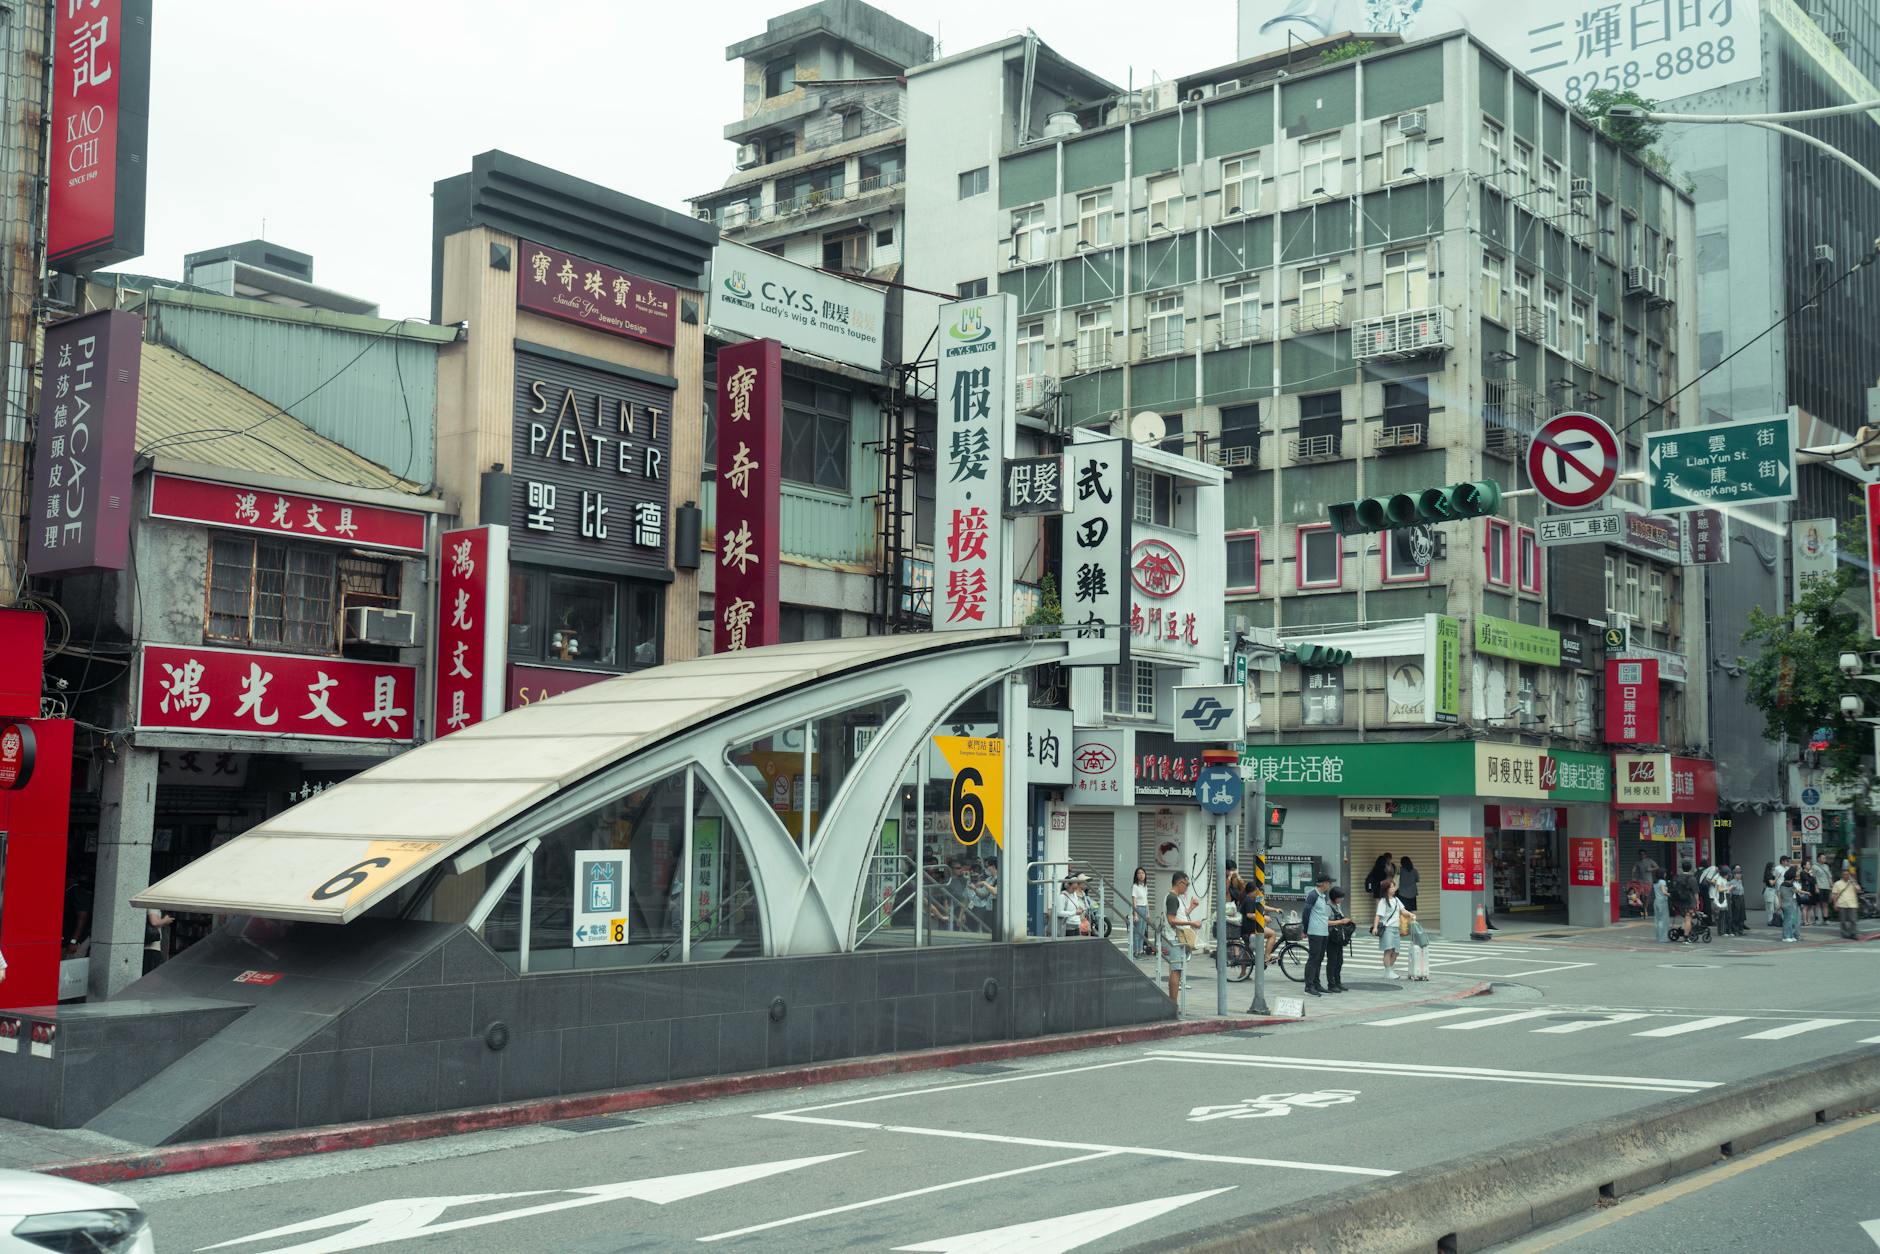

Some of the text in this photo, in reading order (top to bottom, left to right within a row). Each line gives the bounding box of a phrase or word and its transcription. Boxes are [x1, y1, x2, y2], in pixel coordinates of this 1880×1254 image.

[69, 0, 111, 97] 記
[1565, 36, 1736, 102] 8258-8888
[66, 105, 104, 143] KAO
[69, 138, 99, 172] CHI
[69, 171, 98, 187] SINCE 1949
[532, 251, 631, 308] 寶奇珠寶
[553, 294, 581, 309] Sandra
[761, 282, 819, 314] C.Y.S.
[822, 300, 849, 325] 假髮
[599, 313, 648, 335] Jewelry Design
[761, 302, 789, 318] Lady's
[791, 312, 808, 325] wig
[810, 316, 817, 327] &
[819, 321, 846, 335] man's
[847, 329, 877, 344] toupee
[976, 342, 993, 352] WIG
[63, 335, 96, 546] PHACADE
[532, 380, 662, 466] SAINT
[44, 343, 73, 549] 法莎德頭皮護理
[530, 423, 662, 479] PETER
[1661, 428, 1776, 460] 連雲街
[1733, 451, 1750, 461] St.
[1007, 462, 1060, 506] 假髮
[1663, 460, 1777, 489] 永康街
[1740, 482, 1756, 492] St.
[235, 493, 358, 538] 鴻光文具
[528, 481, 662, 548] 聖比德
[721, 365, 760, 652] 寶奇珠寶
[1542, 517, 1618, 539] 左側二車道
[1075, 459, 1112, 639] 武田雞肉
[447, 538, 475, 730] 鴻光文具
[1130, 602, 1199, 646] 南門豆花
[159, 658, 407, 732] 鴻光文具
[1309, 673, 1336, 688] 請上
[1310, 695, 1336, 710] 二樓
[1239, 756, 1343, 783] 健康生活館
[1488, 756, 1534, 784] 阿瘦皮鞋
[1559, 761, 1605, 790] 健康生活館
[952, 767, 984, 842] 6
[1161, 786, 1169, 797] Soy
[1053, 818, 1065, 828] 205
[312, 857, 391, 901] 6
[615, 924, 624, 942] 8
